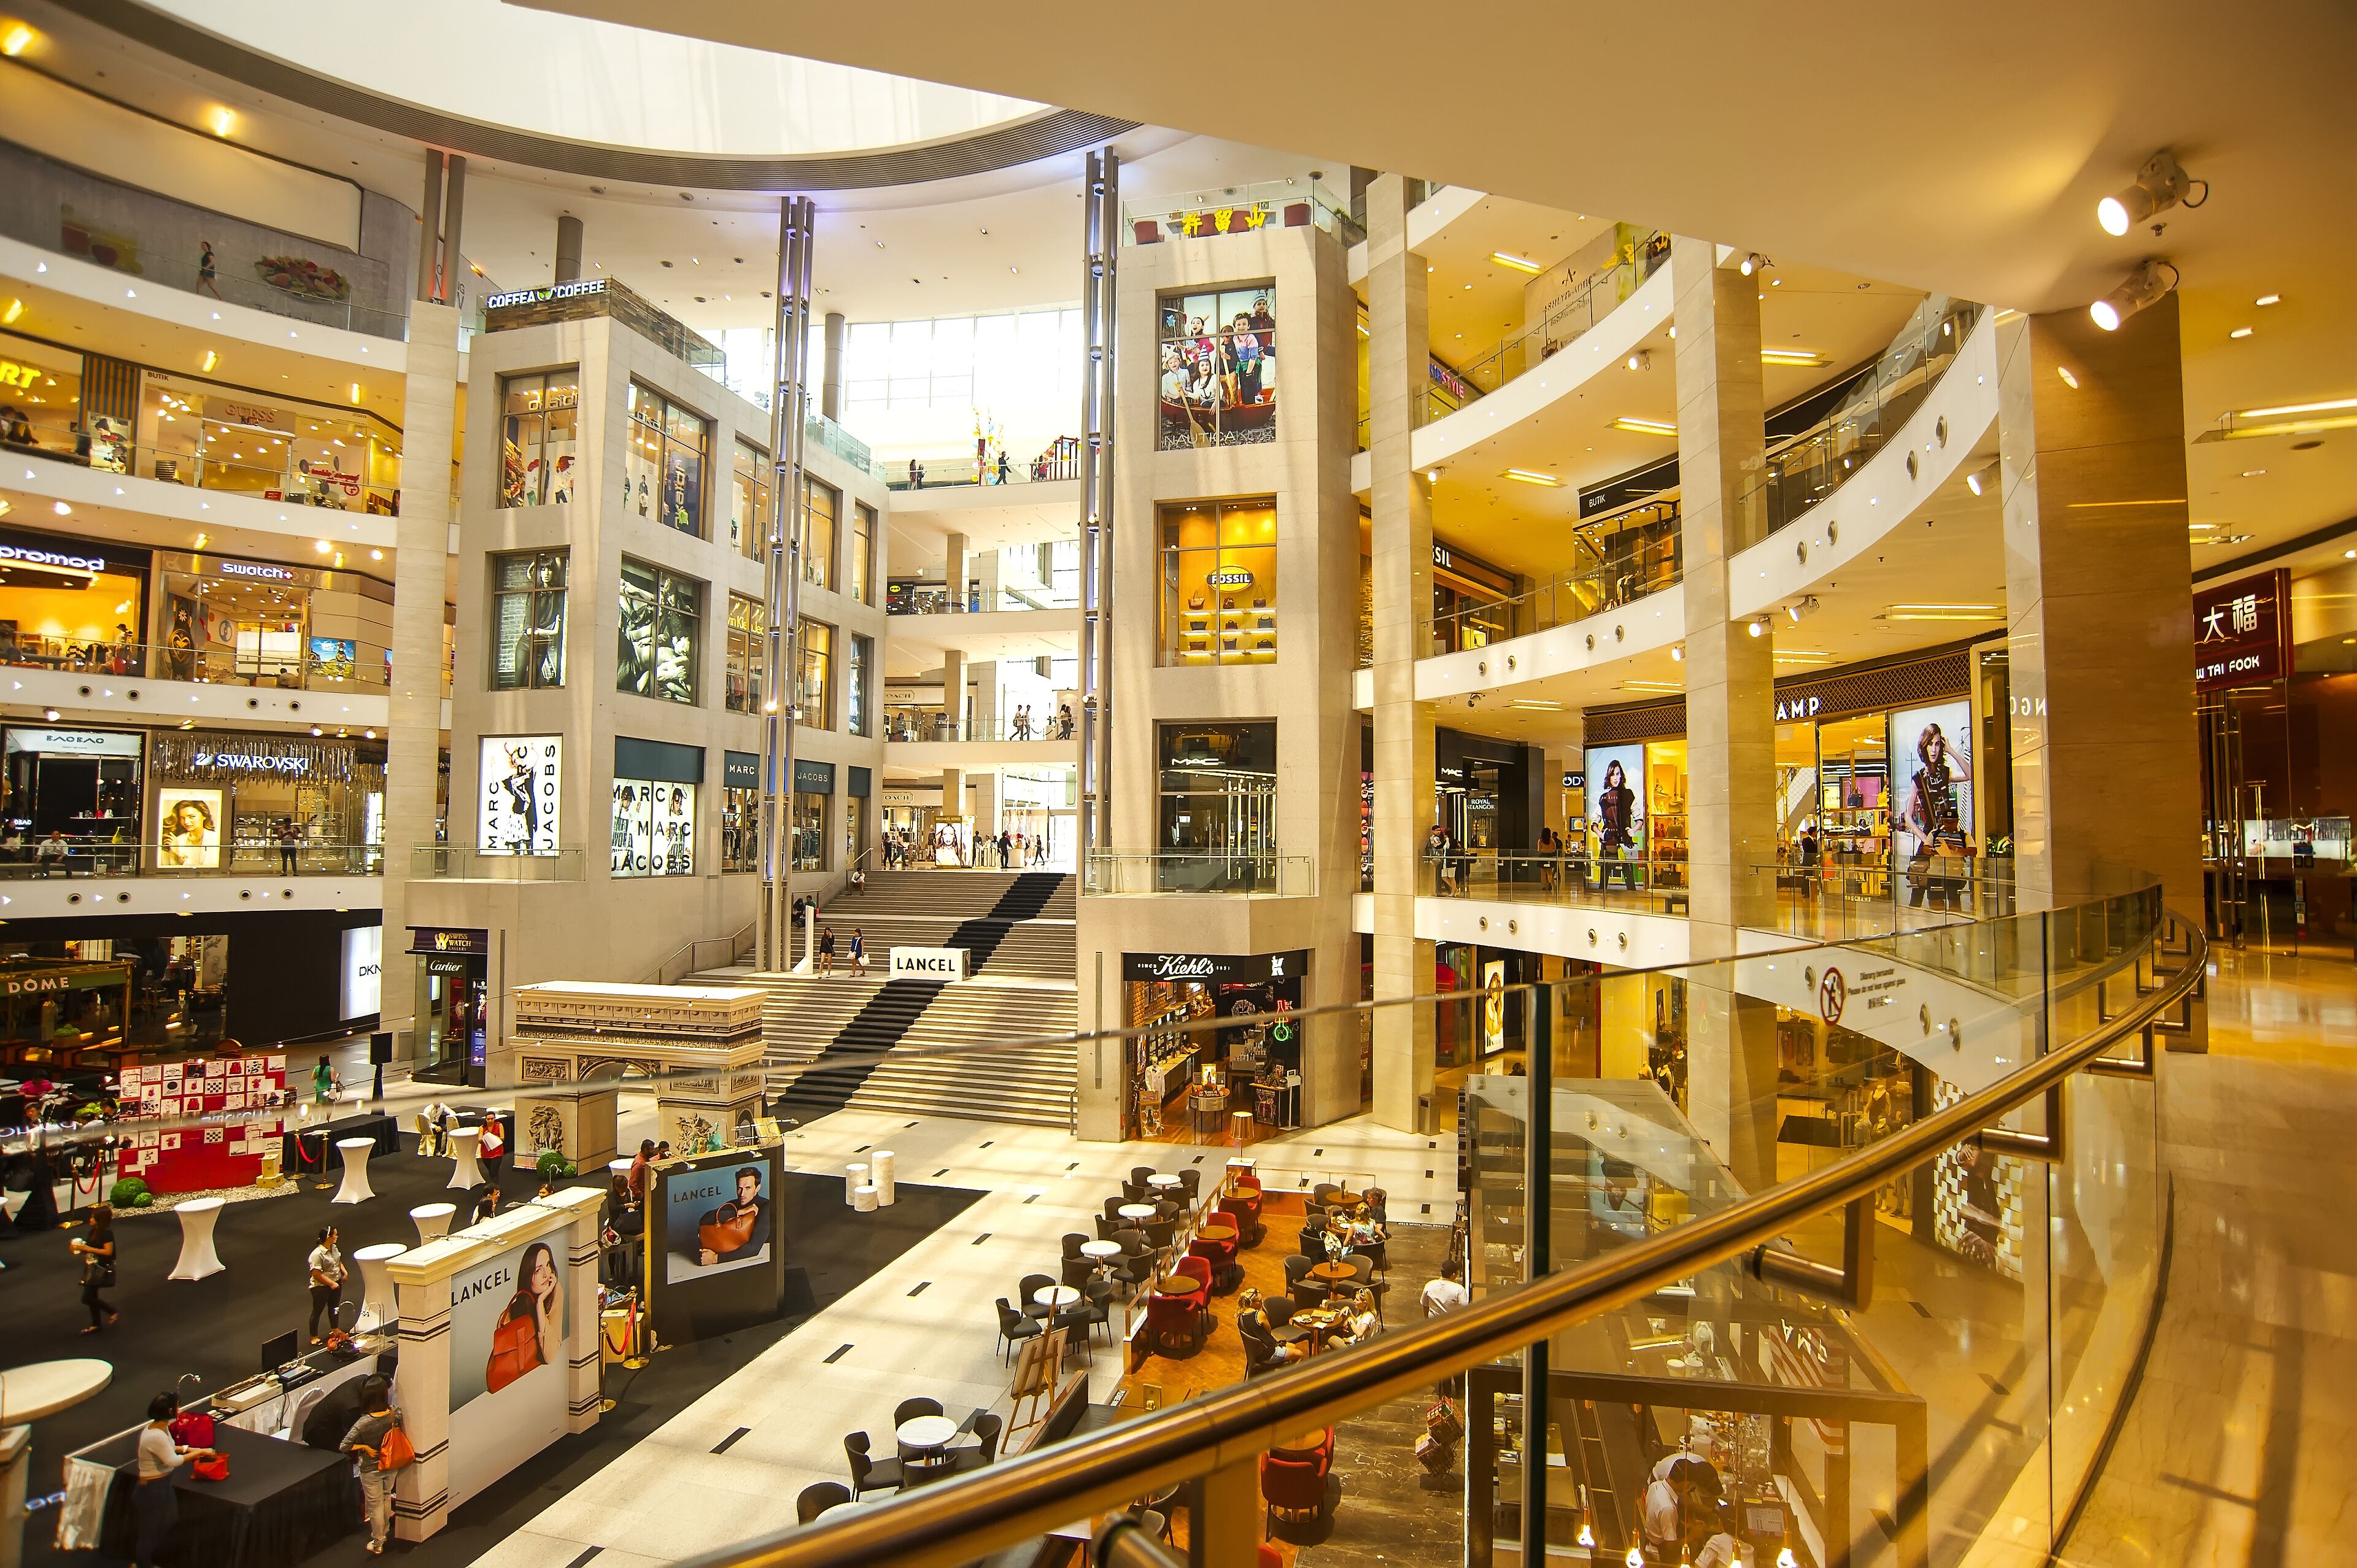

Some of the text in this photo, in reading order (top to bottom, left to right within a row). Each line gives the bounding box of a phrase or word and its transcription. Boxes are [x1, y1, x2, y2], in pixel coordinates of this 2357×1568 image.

[1182, 205, 1266, 236] 許留山
[489, 290, 536, 308] COFFEA
[557, 279, 605, 299] COFFEE
[148, 371, 169, 381] BUTIK
[225, 403, 275, 422] GUESS
[1589, 493, 1606, 508] BUTIK
[0, 544, 104, 571] promod
[1211, 574, 1250, 584] FOSSIL
[2202, 593, 2258, 643] 大福
[2207, 663, 2224, 677] TAI
[2229, 654, 2260, 673] FOOK
[1775, 697, 1822, 721] AMP
[217, 754, 309, 771] SWAROVSKI
[729, 764, 829, 782] MARC JACOBS
[1441, 767, 1463, 778] MAC
[543, 744, 555, 849] JACOBS
[487, 781, 499, 849] MARC
[638, 821, 691, 836] MARC
[611, 854, 690, 871] JACOBS
[430, 959, 462, 972] Cartier
[897, 957, 956, 971] LANCEL
[1153, 955, 1214, 975] Kiehl's
[8, 977, 69, 993] DÔME
[673, 1186, 722, 1203] LANCEL
[451, 1267, 511, 1307] LANCEL
